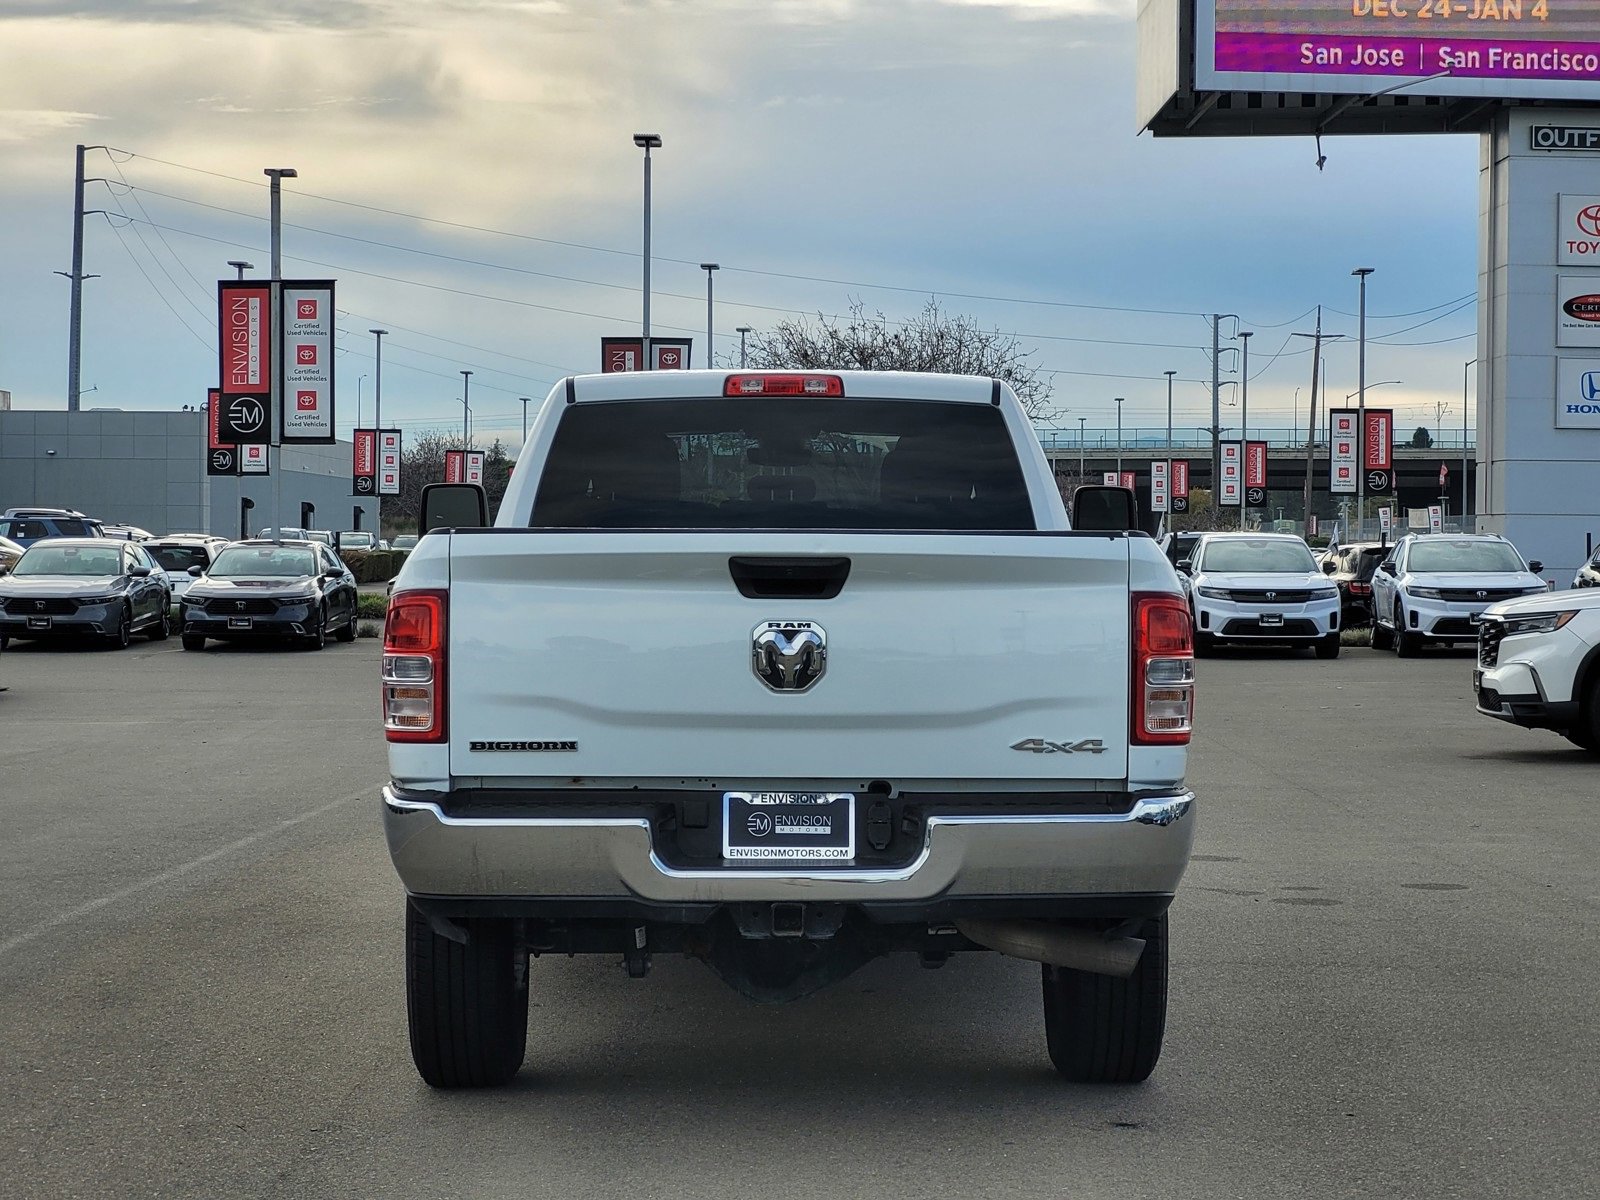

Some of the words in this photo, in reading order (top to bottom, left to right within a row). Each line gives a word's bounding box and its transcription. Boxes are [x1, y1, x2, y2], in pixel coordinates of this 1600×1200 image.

[1352, 0, 1408, 17] DEC
[1417, 0, 1522, 20] 24-JAN
[1531, 0, 1549, 21] 4
[1300, 42, 1342, 65] San
[1351, 44, 1404, 67] Jose
[1438, 46, 1480, 68] San
[1488, 48, 1599, 72] Francisco
[1566, 241, 1600, 254] TOY
[232, 297, 248, 385] ENVISION
[1369, 417, 1379, 465] ENVISION
[358, 435, 366, 473] ENVISION
[1249, 447, 1257, 484] ENVISION
[469, 741, 578, 752] BIGHORN
[761, 793, 817, 804] ENVISION
[774, 815, 832, 826] ENVISION
[729, 848, 849, 858] ENVISIONMOTORS.COM
